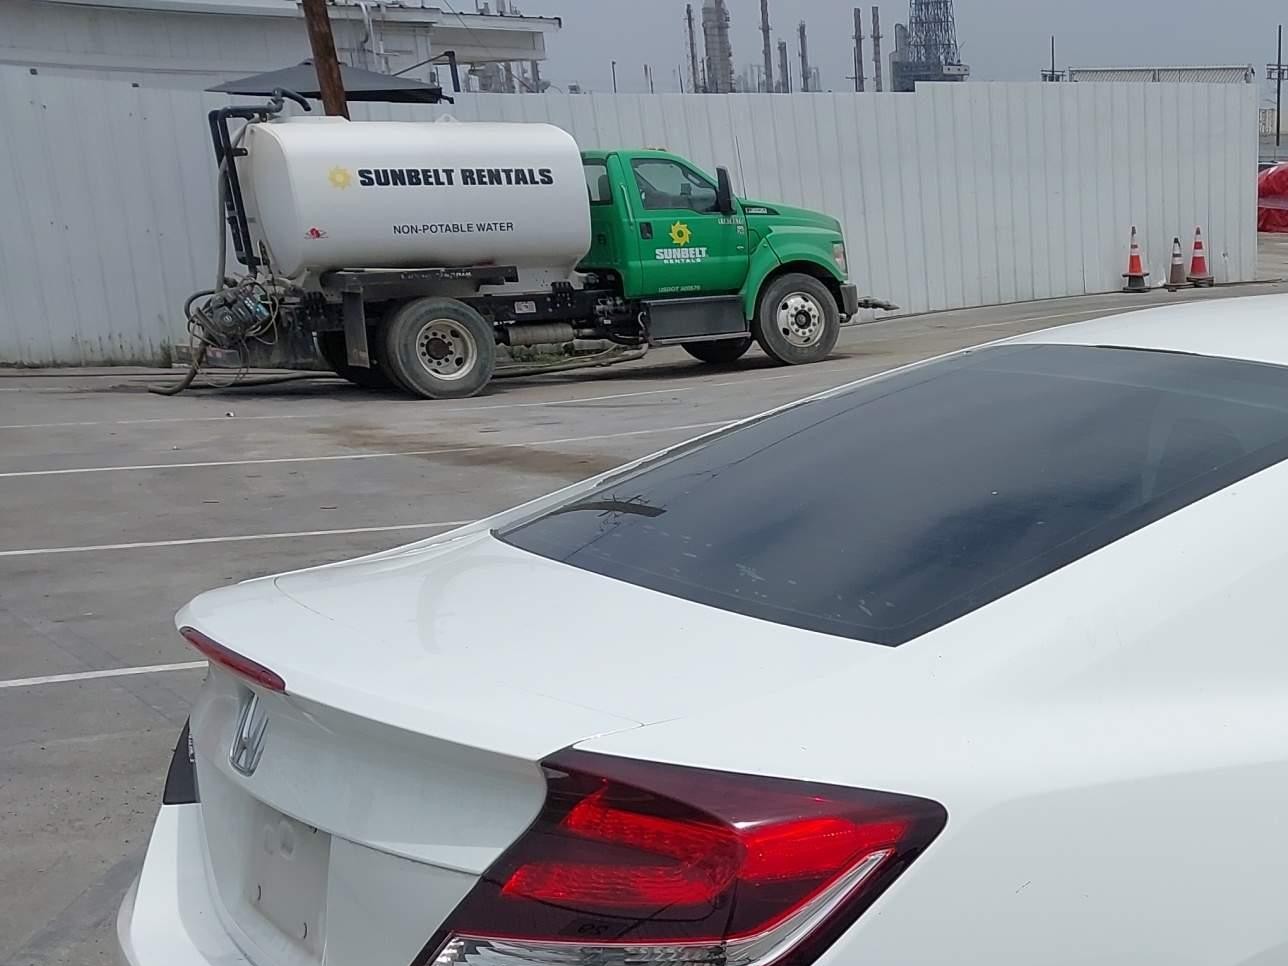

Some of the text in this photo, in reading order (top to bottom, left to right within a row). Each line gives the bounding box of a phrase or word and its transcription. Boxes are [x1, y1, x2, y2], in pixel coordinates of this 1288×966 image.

[358, 168, 554, 187] SUNBELT RENTALS
[393, 222, 514, 235] NON-POTABLE WATER
[655, 247, 707, 260] SUNBELT
